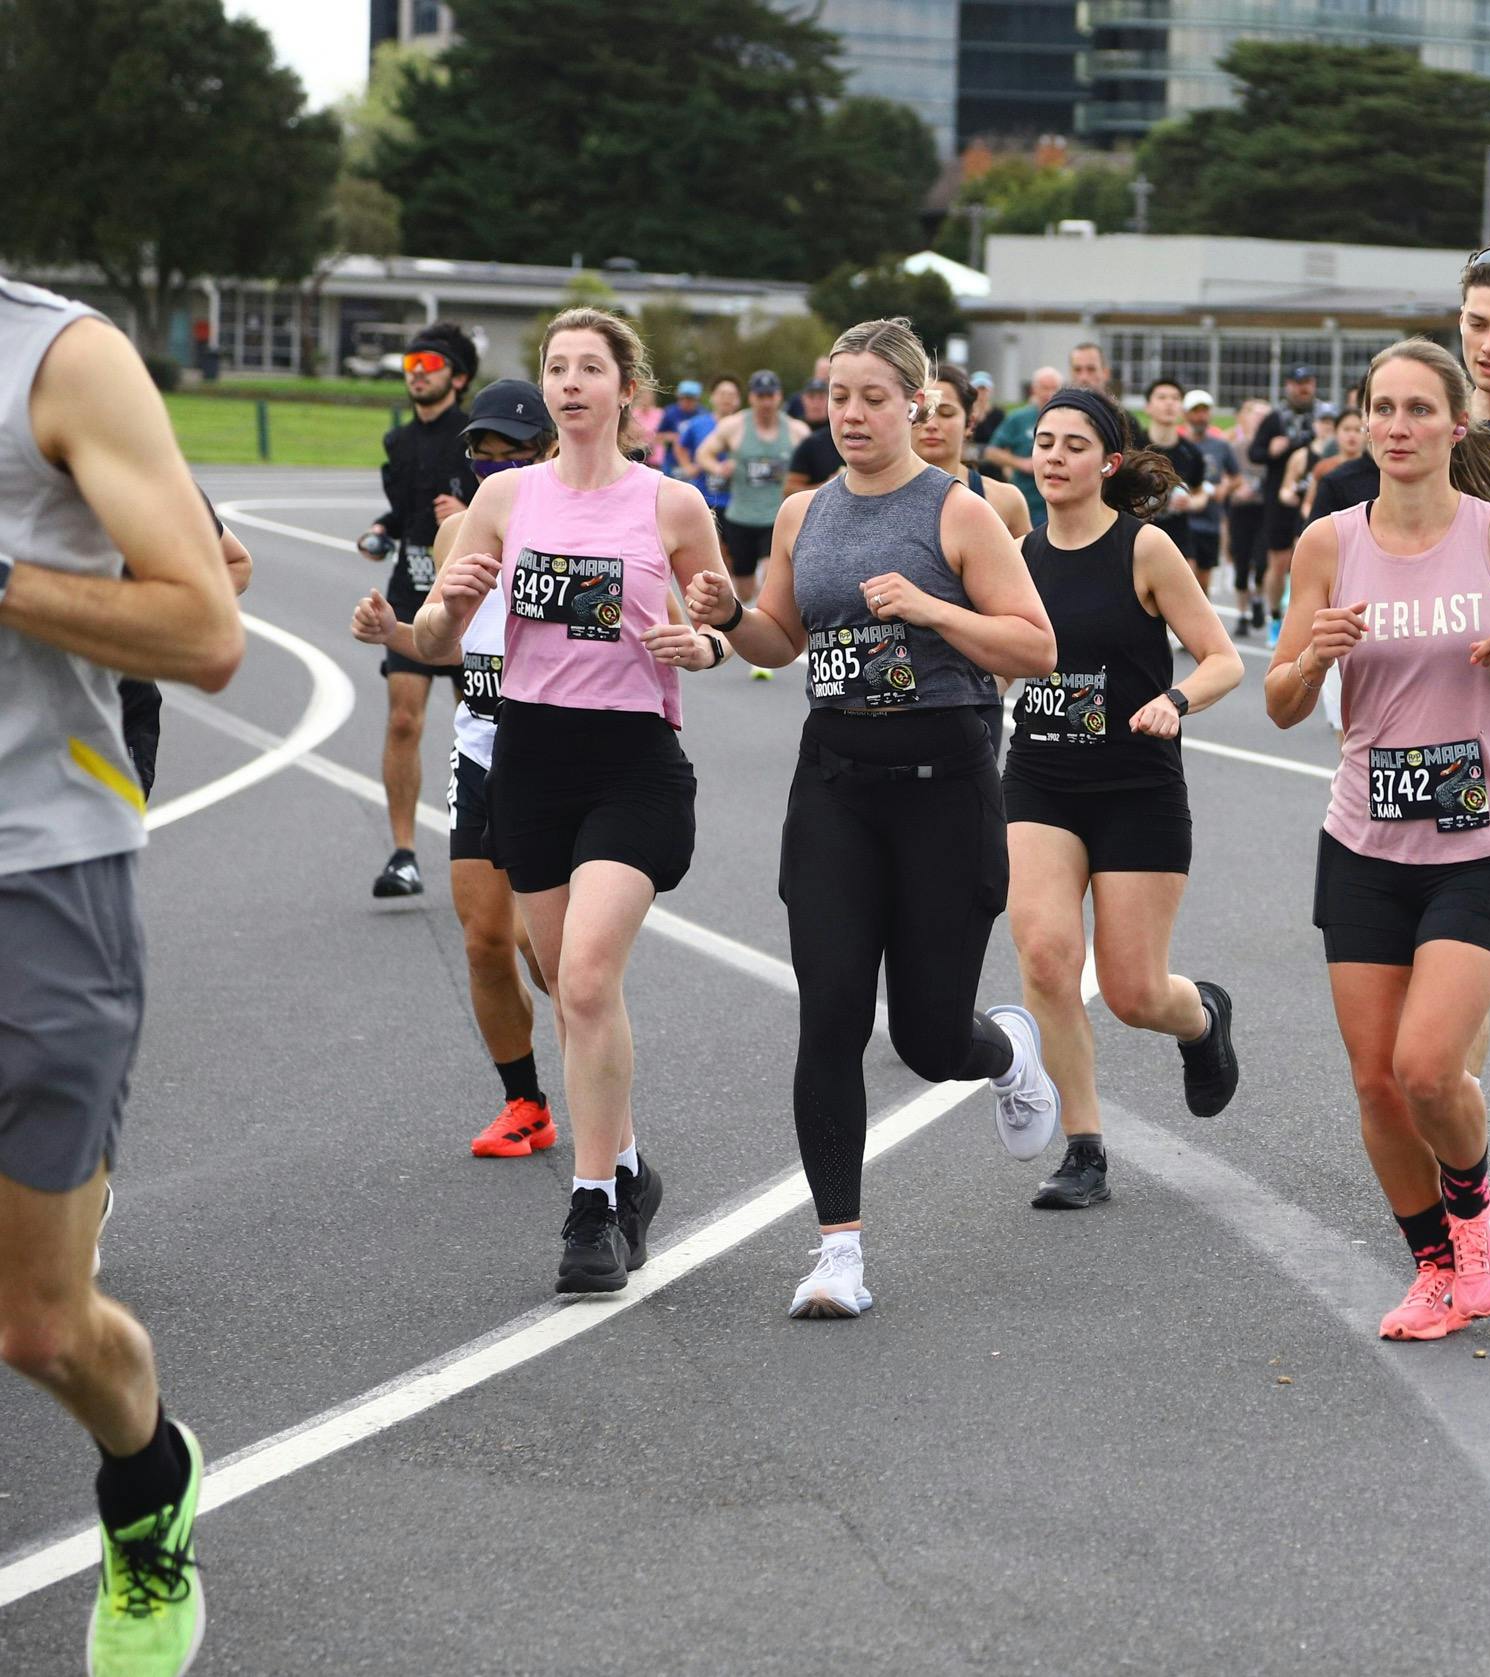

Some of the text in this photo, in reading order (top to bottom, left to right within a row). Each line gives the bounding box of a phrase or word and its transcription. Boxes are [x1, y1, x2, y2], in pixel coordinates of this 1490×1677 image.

[516, 551, 550, 572] HALF
[513, 568, 571, 607] 3497
[515, 600, 544, 619] GEMMA
[1360, 592, 1483, 642] VERLAST
[809, 630, 837, 650] HALF
[464, 655, 490, 670] HALF
[810, 647, 860, 683] 3685
[463, 669, 501, 698] 3911
[815, 680, 845, 698] BROOKE
[1025, 685, 1065, 717] 3902
[1046, 732, 1060, 742] 3902
[1370, 748, 1405, 769] HALF
[1372, 768, 1432, 803] 3742
[1377, 802, 1403, 818] KARA
